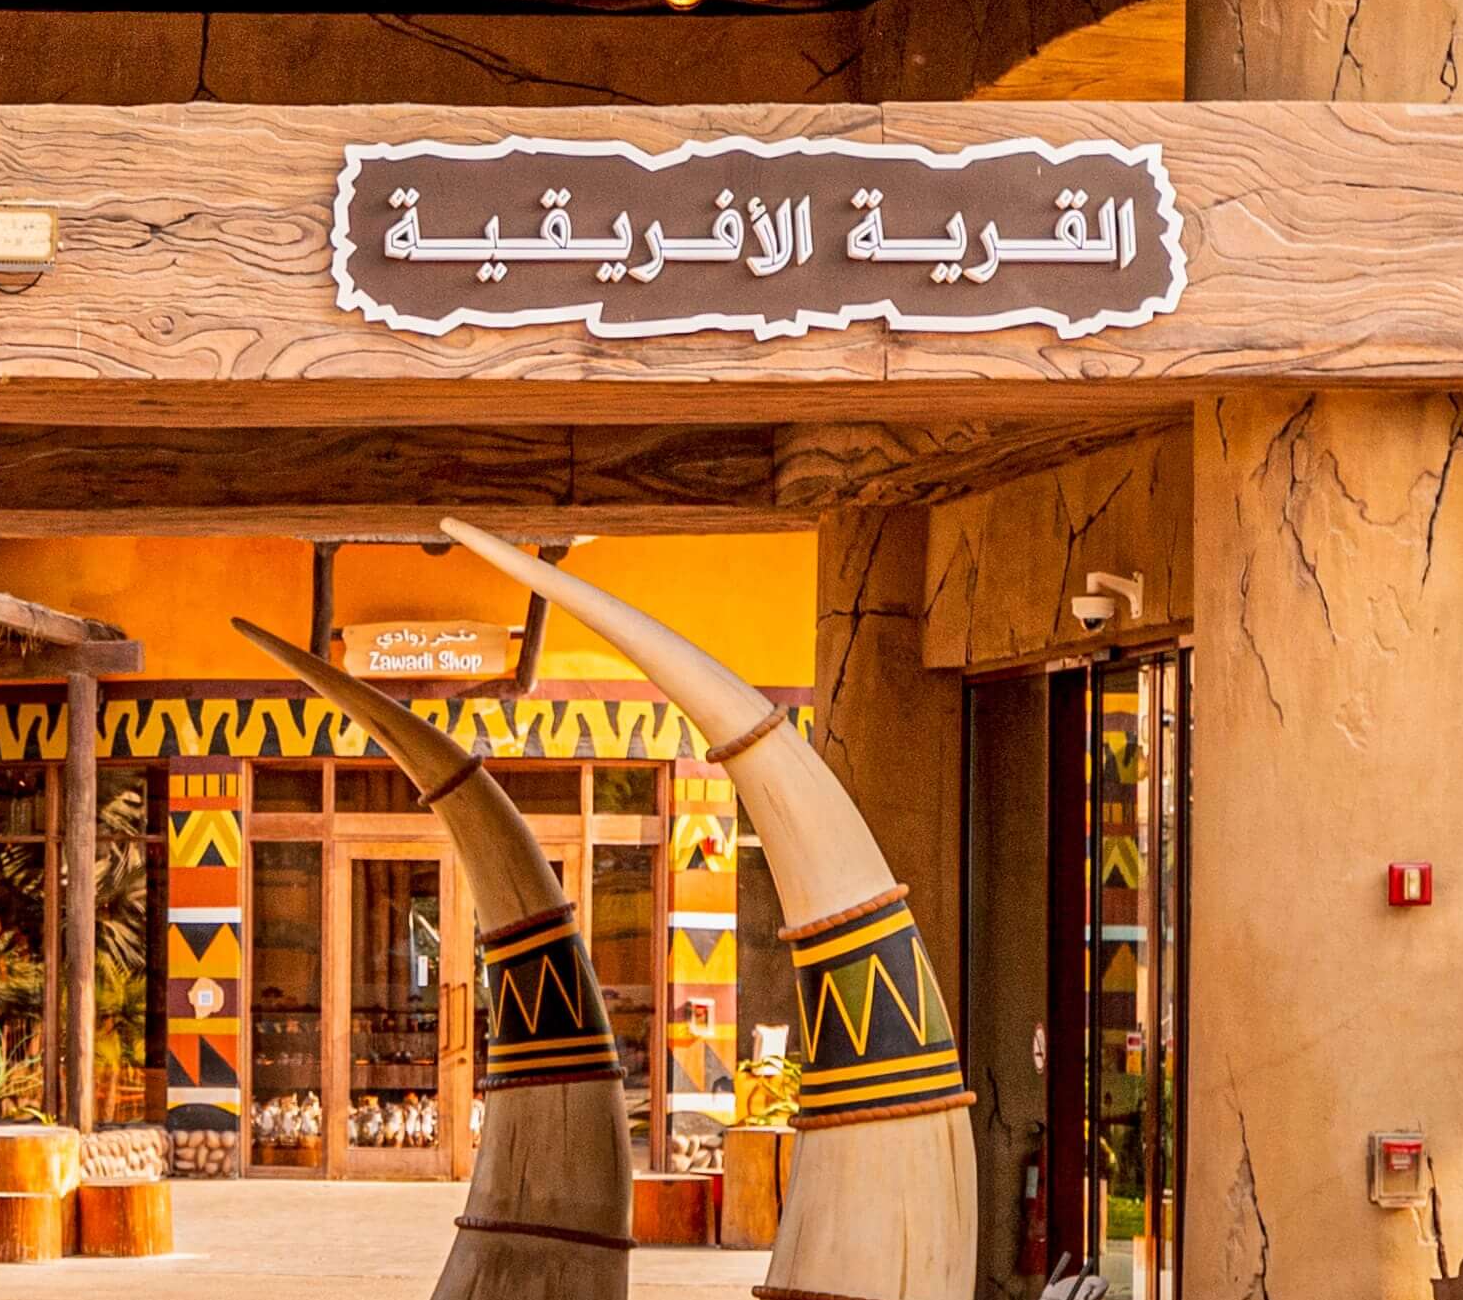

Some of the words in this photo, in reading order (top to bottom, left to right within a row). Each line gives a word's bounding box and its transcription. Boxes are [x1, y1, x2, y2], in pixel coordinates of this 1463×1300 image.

[383, 188, 815, 283] الأفريقية
[846, 188, 1137, 285] القرية
[376, 627, 427, 650] زوادي
[430, 629, 478, 648] متجر
[369, 651, 434, 672] Zawadi
[438, 650, 484, 674] Shop
